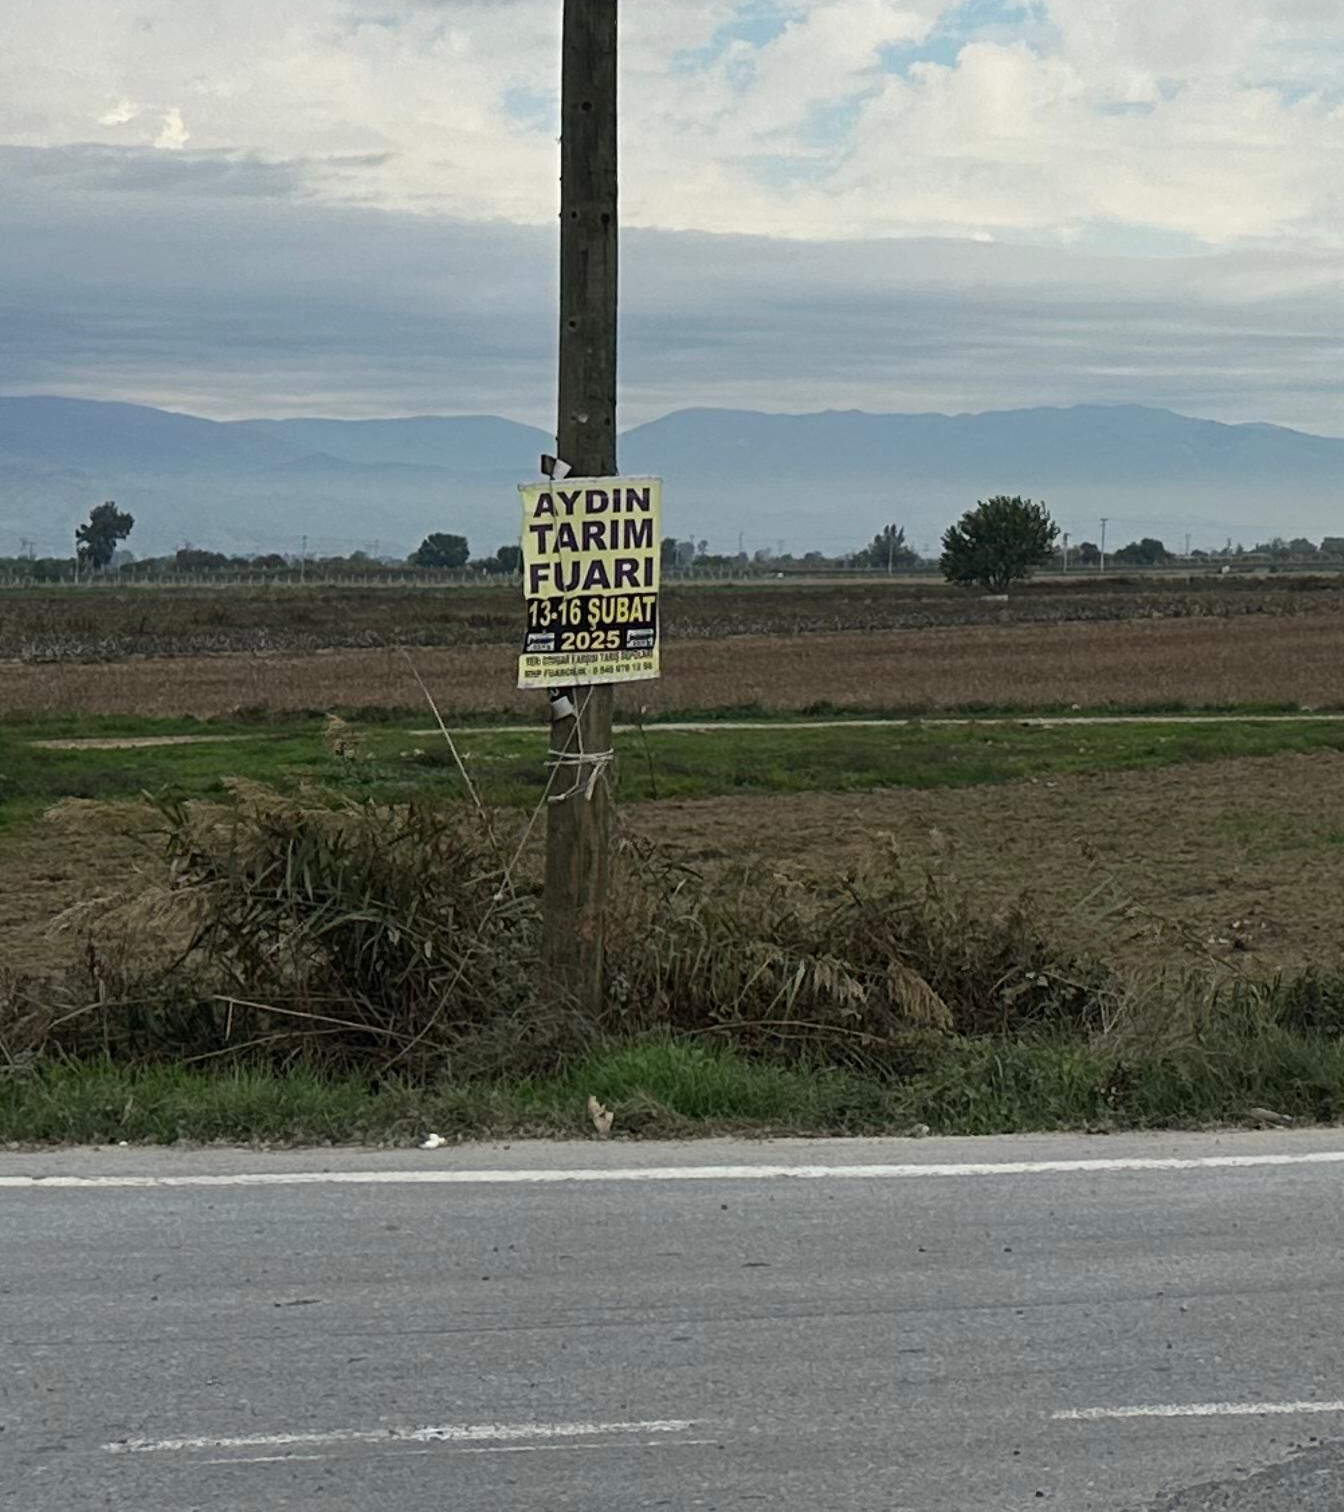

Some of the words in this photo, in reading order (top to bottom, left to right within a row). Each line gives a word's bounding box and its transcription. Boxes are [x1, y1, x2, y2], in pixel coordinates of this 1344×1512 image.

[532, 487, 651, 518] AYDIN
[529, 517, 654, 555] TARIM
[529, 556, 654, 595] FUARI
[529, 598, 582, 627] 13-16
[587, 595, 656, 631] ŞUBAT
[560, 630, 621, 651] 2025
